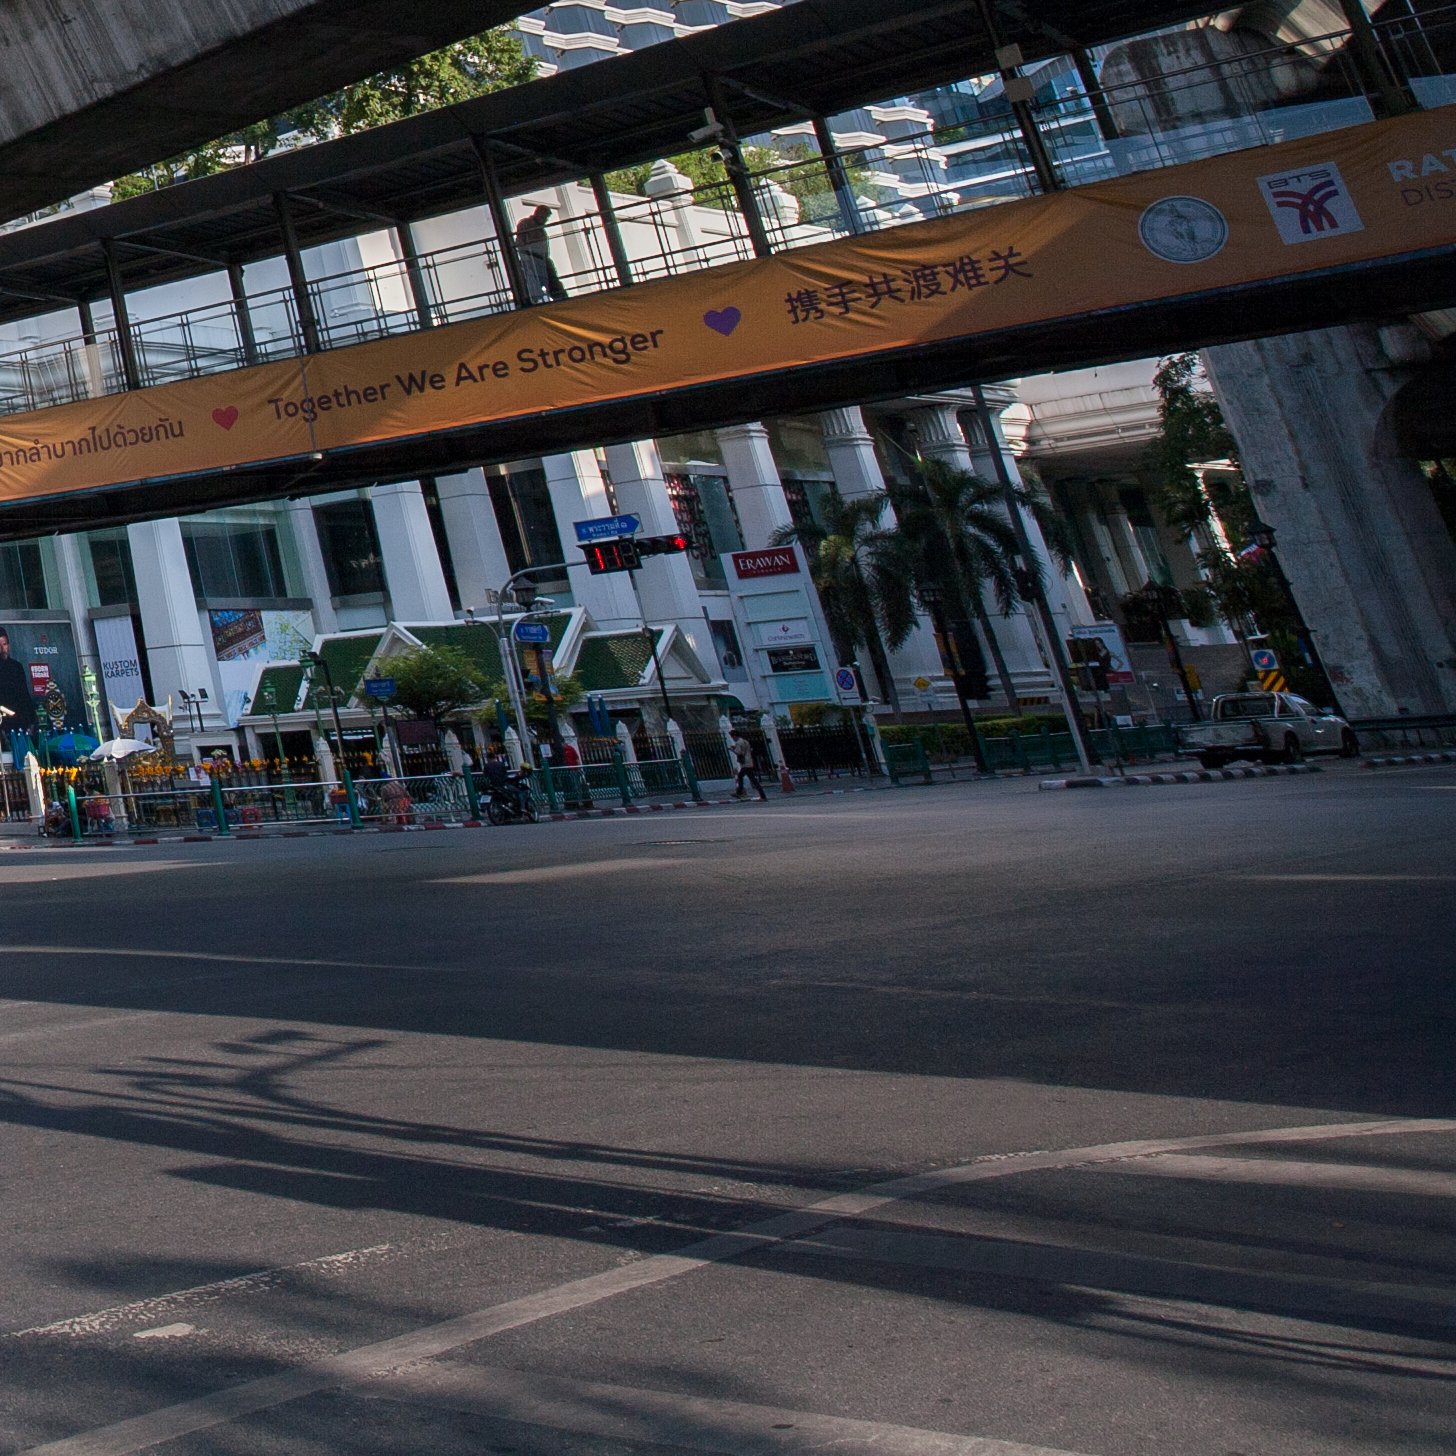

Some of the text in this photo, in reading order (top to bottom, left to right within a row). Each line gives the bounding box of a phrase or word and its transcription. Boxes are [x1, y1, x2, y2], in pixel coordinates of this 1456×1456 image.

[1267, 168, 1332, 190] BTS
[1400, 179, 1456, 206] DIS
[783, 245, 1034, 325] 携手共渡难关
[268, 328, 665, 423] Together We Are Stronger
[738, 553, 791, 571] ERAWAN
[33, 646, 59, 655] TUDOR
[103, 659, 138, 671] KUSTOM
[104, 667, 140, 679] KARPETS
